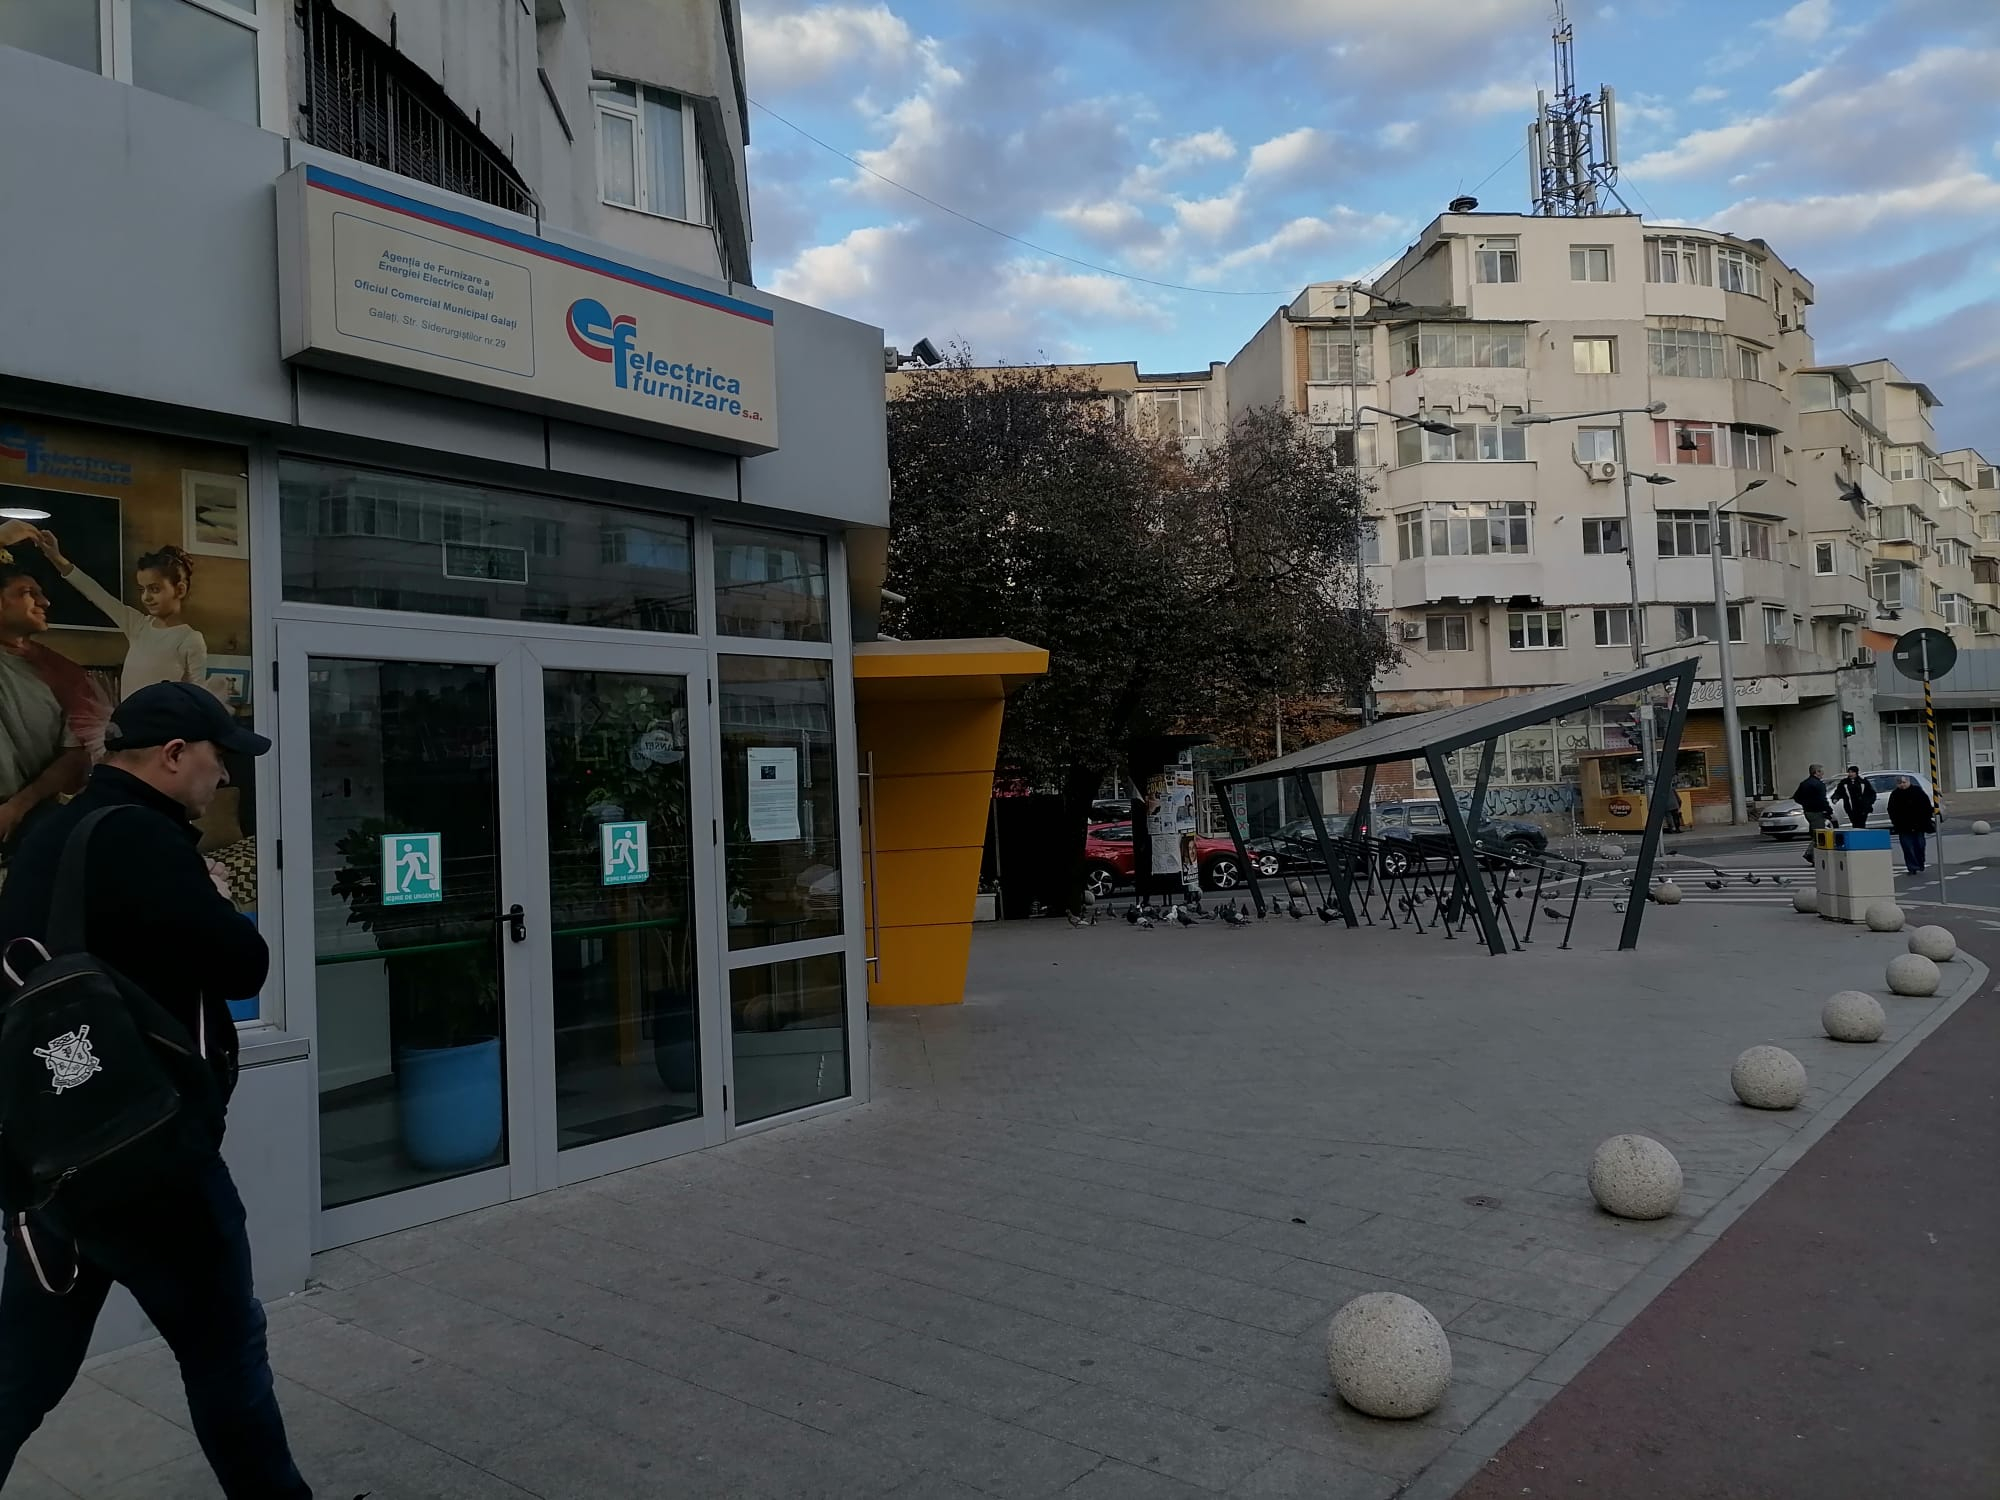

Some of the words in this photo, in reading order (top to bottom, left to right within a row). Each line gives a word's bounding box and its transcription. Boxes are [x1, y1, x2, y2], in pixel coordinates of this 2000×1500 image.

[379, 261, 420, 280] Energiei
[423, 272, 465, 291] Electrice
[467, 285, 494, 300] Galați
[423, 262, 435, 271] de
[437, 265, 482, 284] Furnizare
[354, 279, 388, 295] Oficiul
[391, 288, 441, 309] Comercial
[443, 302, 489, 322] Municipal
[490, 314, 517, 330] Galați
[402, 315, 418, 328] Str.
[629, 351, 741, 396] electrica
[633, 371, 742, 416] furnizare
[742, 408, 763, 421] s.a.
